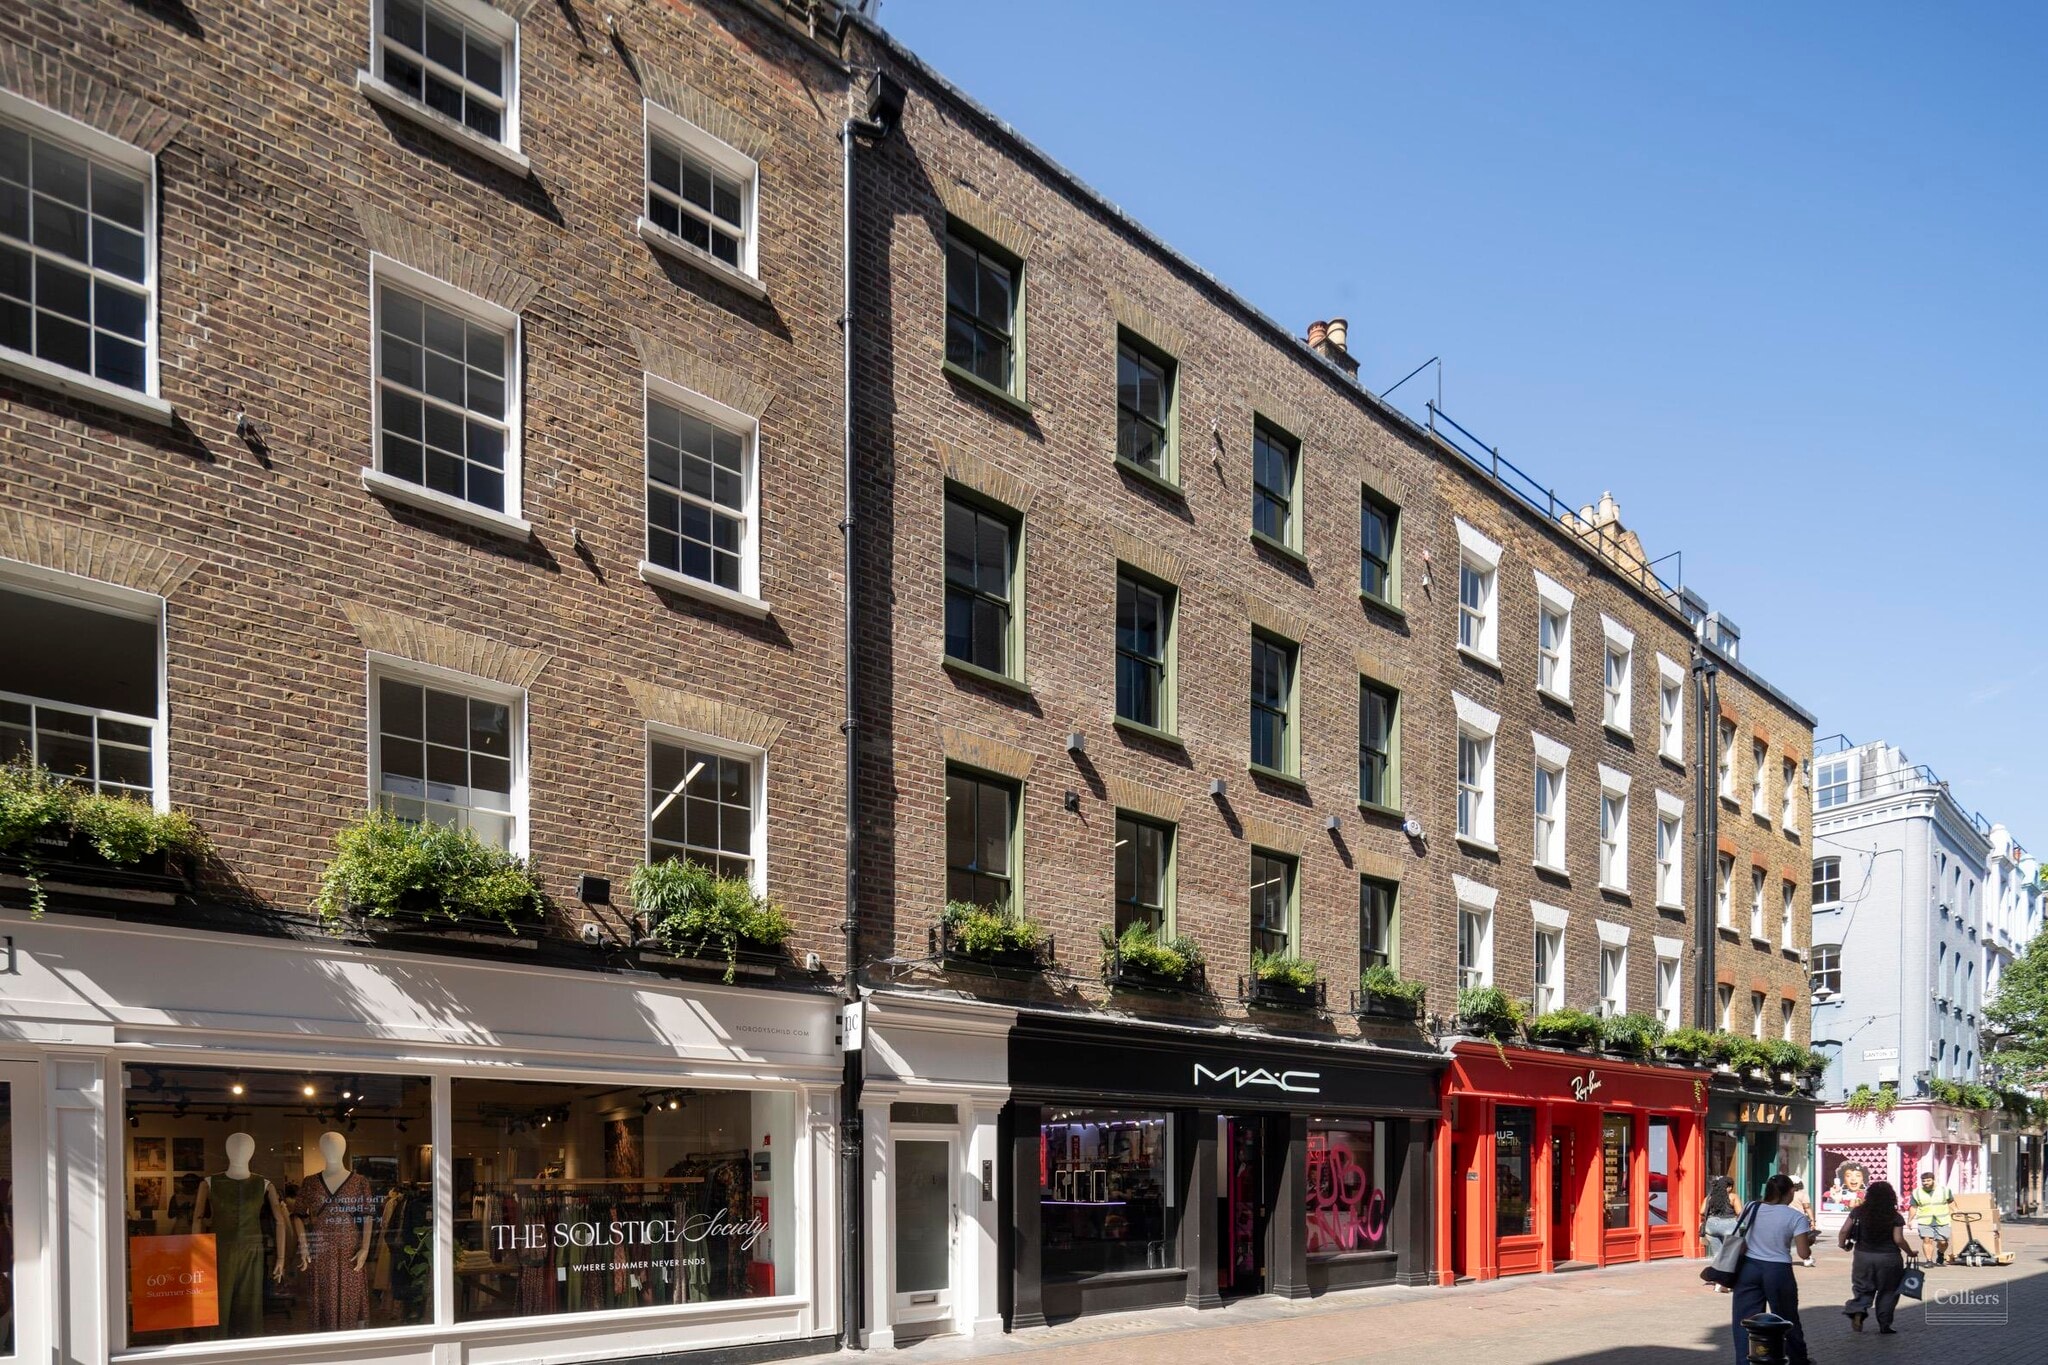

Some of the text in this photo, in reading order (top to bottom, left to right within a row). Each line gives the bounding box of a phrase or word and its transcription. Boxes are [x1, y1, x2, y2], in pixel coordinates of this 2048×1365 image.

[736, 1025, 810, 1037] NOBODYSCHILD.COM
[845, 1014, 858, 1032] nc
[491, 1224, 546, 1250] THE
[553, 1219, 677, 1247] SOLSTICE
[676, 1207, 769, 1251] Society
[573, 1257, 706, 1272] WHERE SUMMER NEVER ENDS
[146, 1270, 205, 1287] 60% Off
[146, 1287, 204, 1298] Summer Sale
